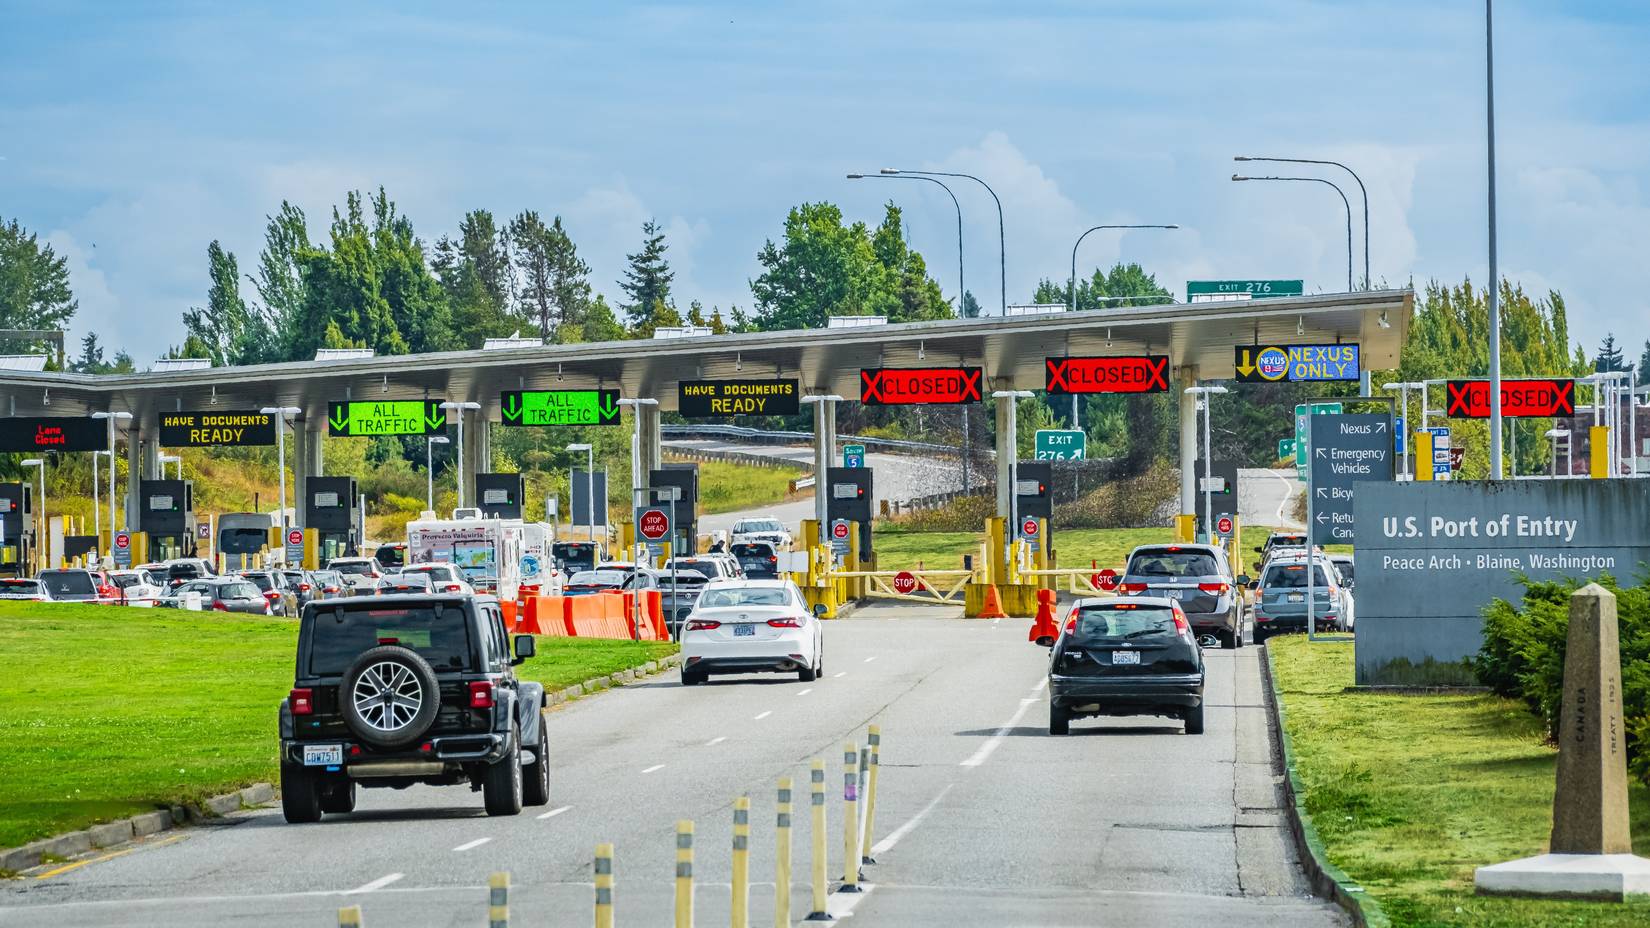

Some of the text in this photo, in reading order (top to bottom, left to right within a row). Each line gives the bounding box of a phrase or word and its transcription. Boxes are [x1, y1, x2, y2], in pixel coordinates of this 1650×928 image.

[1246, 282, 1271, 292] 276
[1290, 347, 1354, 362] NEXUS
[1260, 357, 1285, 365] NEXUS
[1069, 366, 1145, 384] CLOSED
[1295, 363, 1348, 378] ONLY
[684, 384, 792, 396] HAVE DOCUMENTS
[883, 377, 959, 395] CLOSED
[547, 394, 574, 407] ALL
[711, 398, 766, 413] READY
[373, 404, 400, 417] ALL
[530, 409, 591, 422] TRAFFIC
[164, 415, 269, 427] HAVE DOCUMENTS
[357, 419, 417, 432] TRAFFIC
[37, 424, 62, 435] Lane
[1340, 423, 1371, 434] Nexus
[35, 434, 65, 445] Closed
[190, 428, 244, 443] READY
[1048, 435, 1073, 445] EXIT
[1038, 451, 1065, 461] 276
[1331, 448, 1385, 461] Emergency
[851, 458, 857, 468] 5
[1331, 462, 1370, 474] Vehicles
[646, 516, 661, 524] STOP
[1332, 512, 1354, 524] Retu
[1383, 514, 1577, 542] U.S. Port of Entry
[1383, 553, 1615, 572] Peace Arch Blaine, Washington
[895, 578, 914, 587] STOP
[1098, 576, 1112, 585] STO
[1576, 687, 1586, 742] CANADA
[1609, 715, 1617, 755] TREATY
